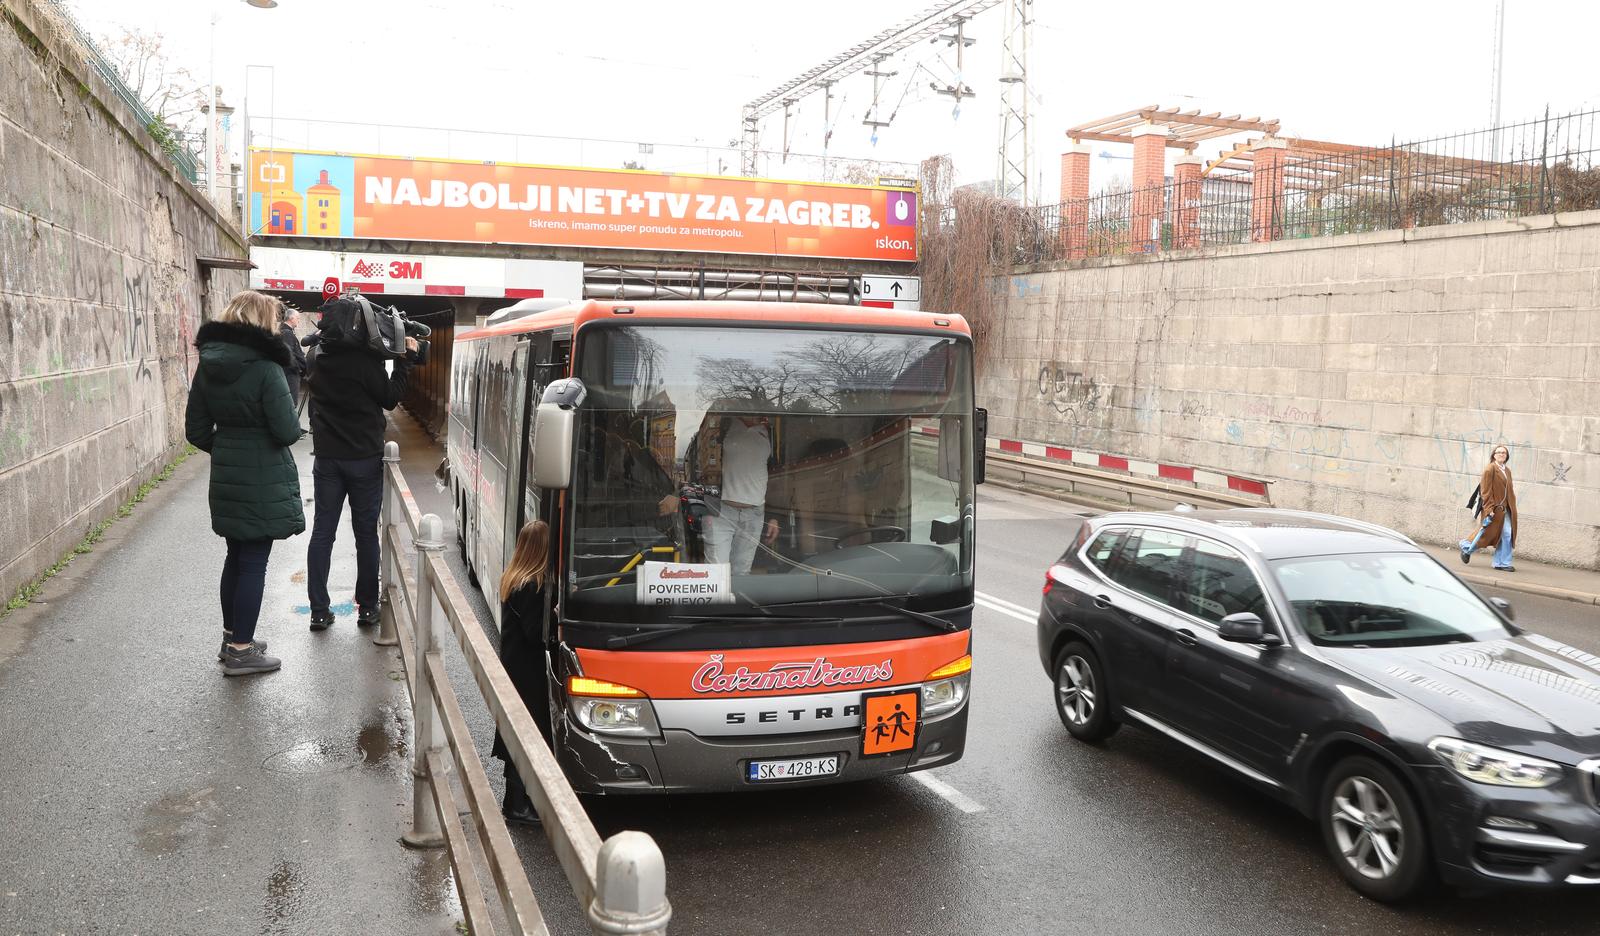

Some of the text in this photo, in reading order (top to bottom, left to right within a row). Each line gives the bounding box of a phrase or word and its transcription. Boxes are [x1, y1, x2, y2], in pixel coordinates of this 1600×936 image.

[365, 175, 880, 230] NAJBOLJI NET+TV ZA ZAGREB.
[571, 221, 606, 232] imamo
[608, 223, 636, 234] super
[639, 224, 677, 236] ponudu
[679, 226, 691, 235] za
[692, 227, 744, 238] metropolu.
[389, 261, 422, 279] 3M
[863, 280, 871, 294] b
[648, 584, 718, 594] POVREMENI
[726, 704, 860, 725] SETRA
[760, 764, 776, 779] SK
[787, 758, 835, 777] 428-KS
